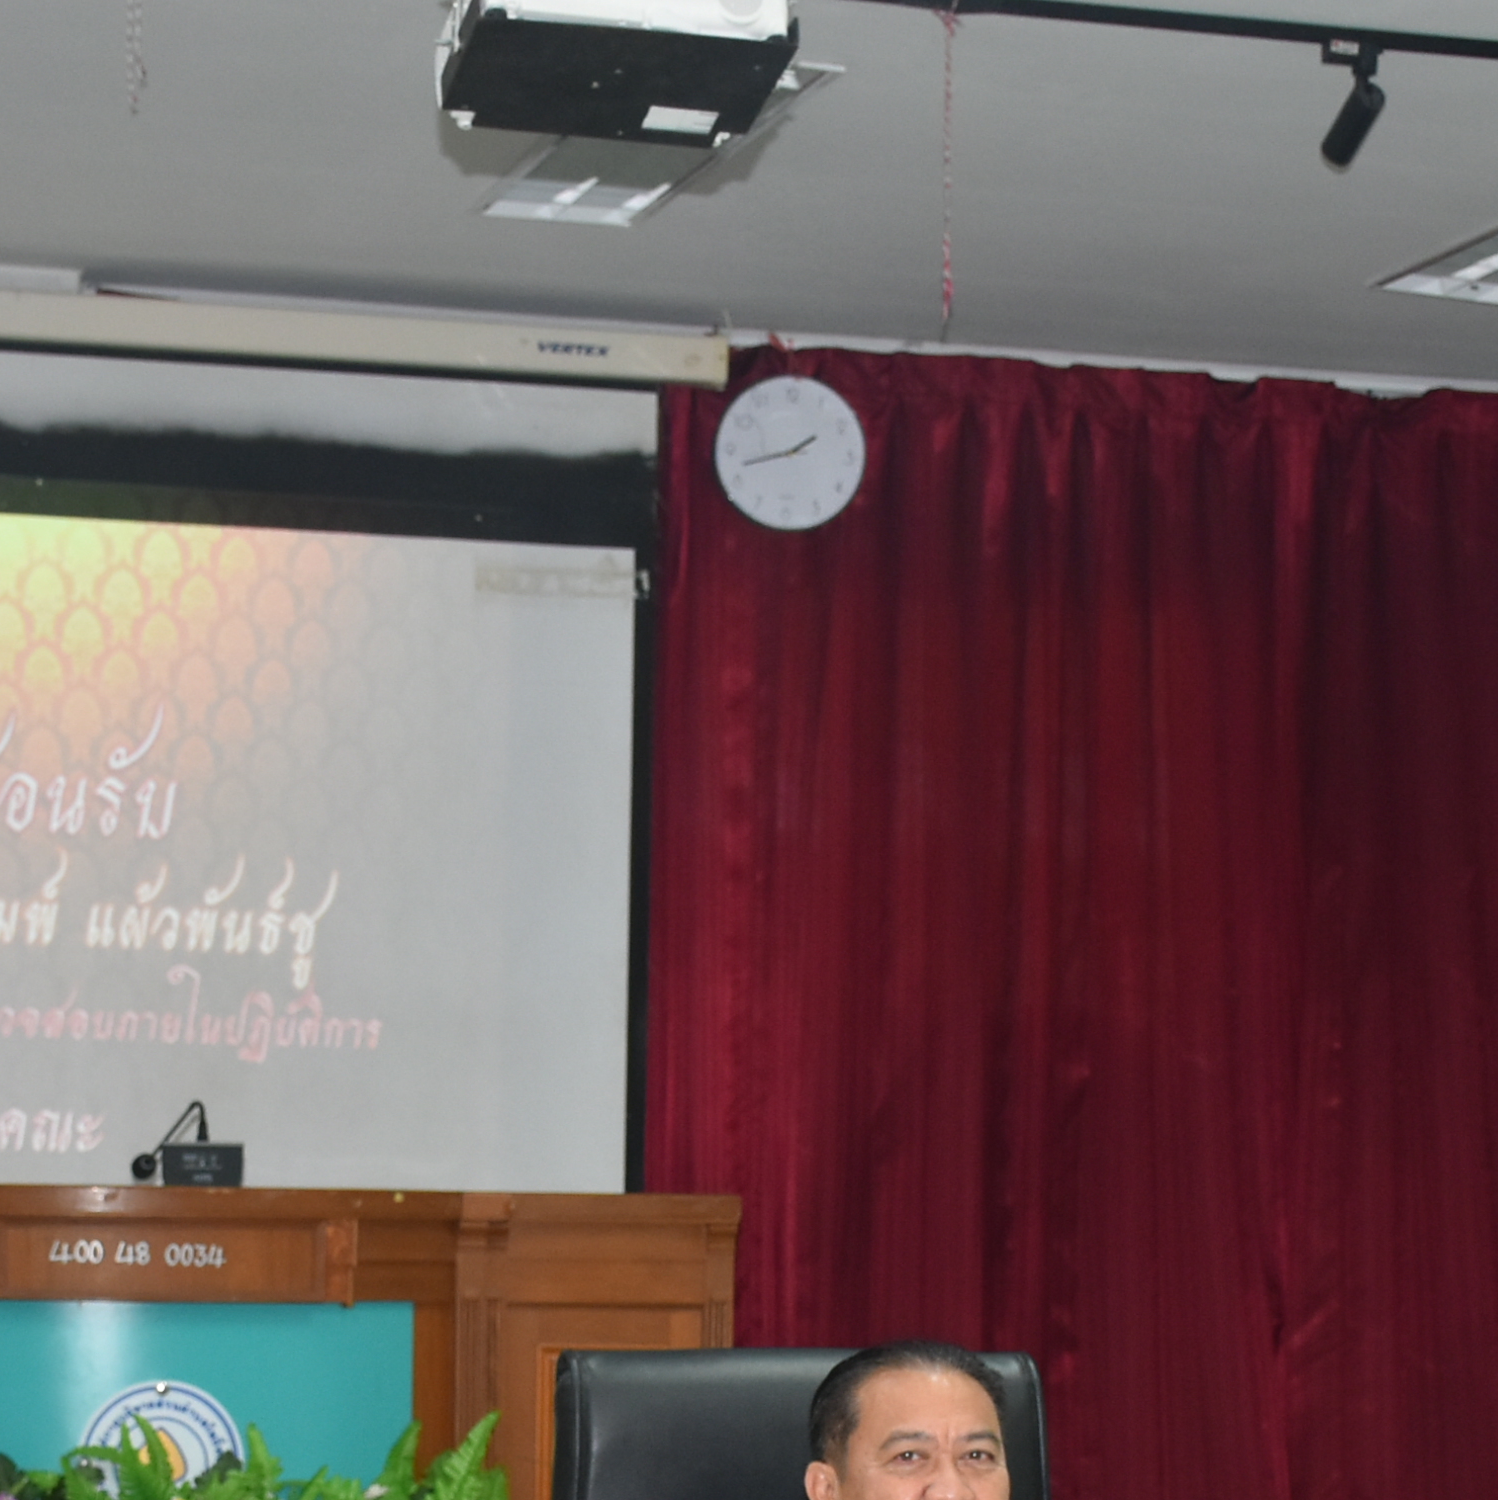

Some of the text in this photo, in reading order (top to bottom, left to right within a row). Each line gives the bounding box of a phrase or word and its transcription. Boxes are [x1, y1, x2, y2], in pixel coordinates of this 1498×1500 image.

[48, 1238, 227, 1269] 400 48 0034
